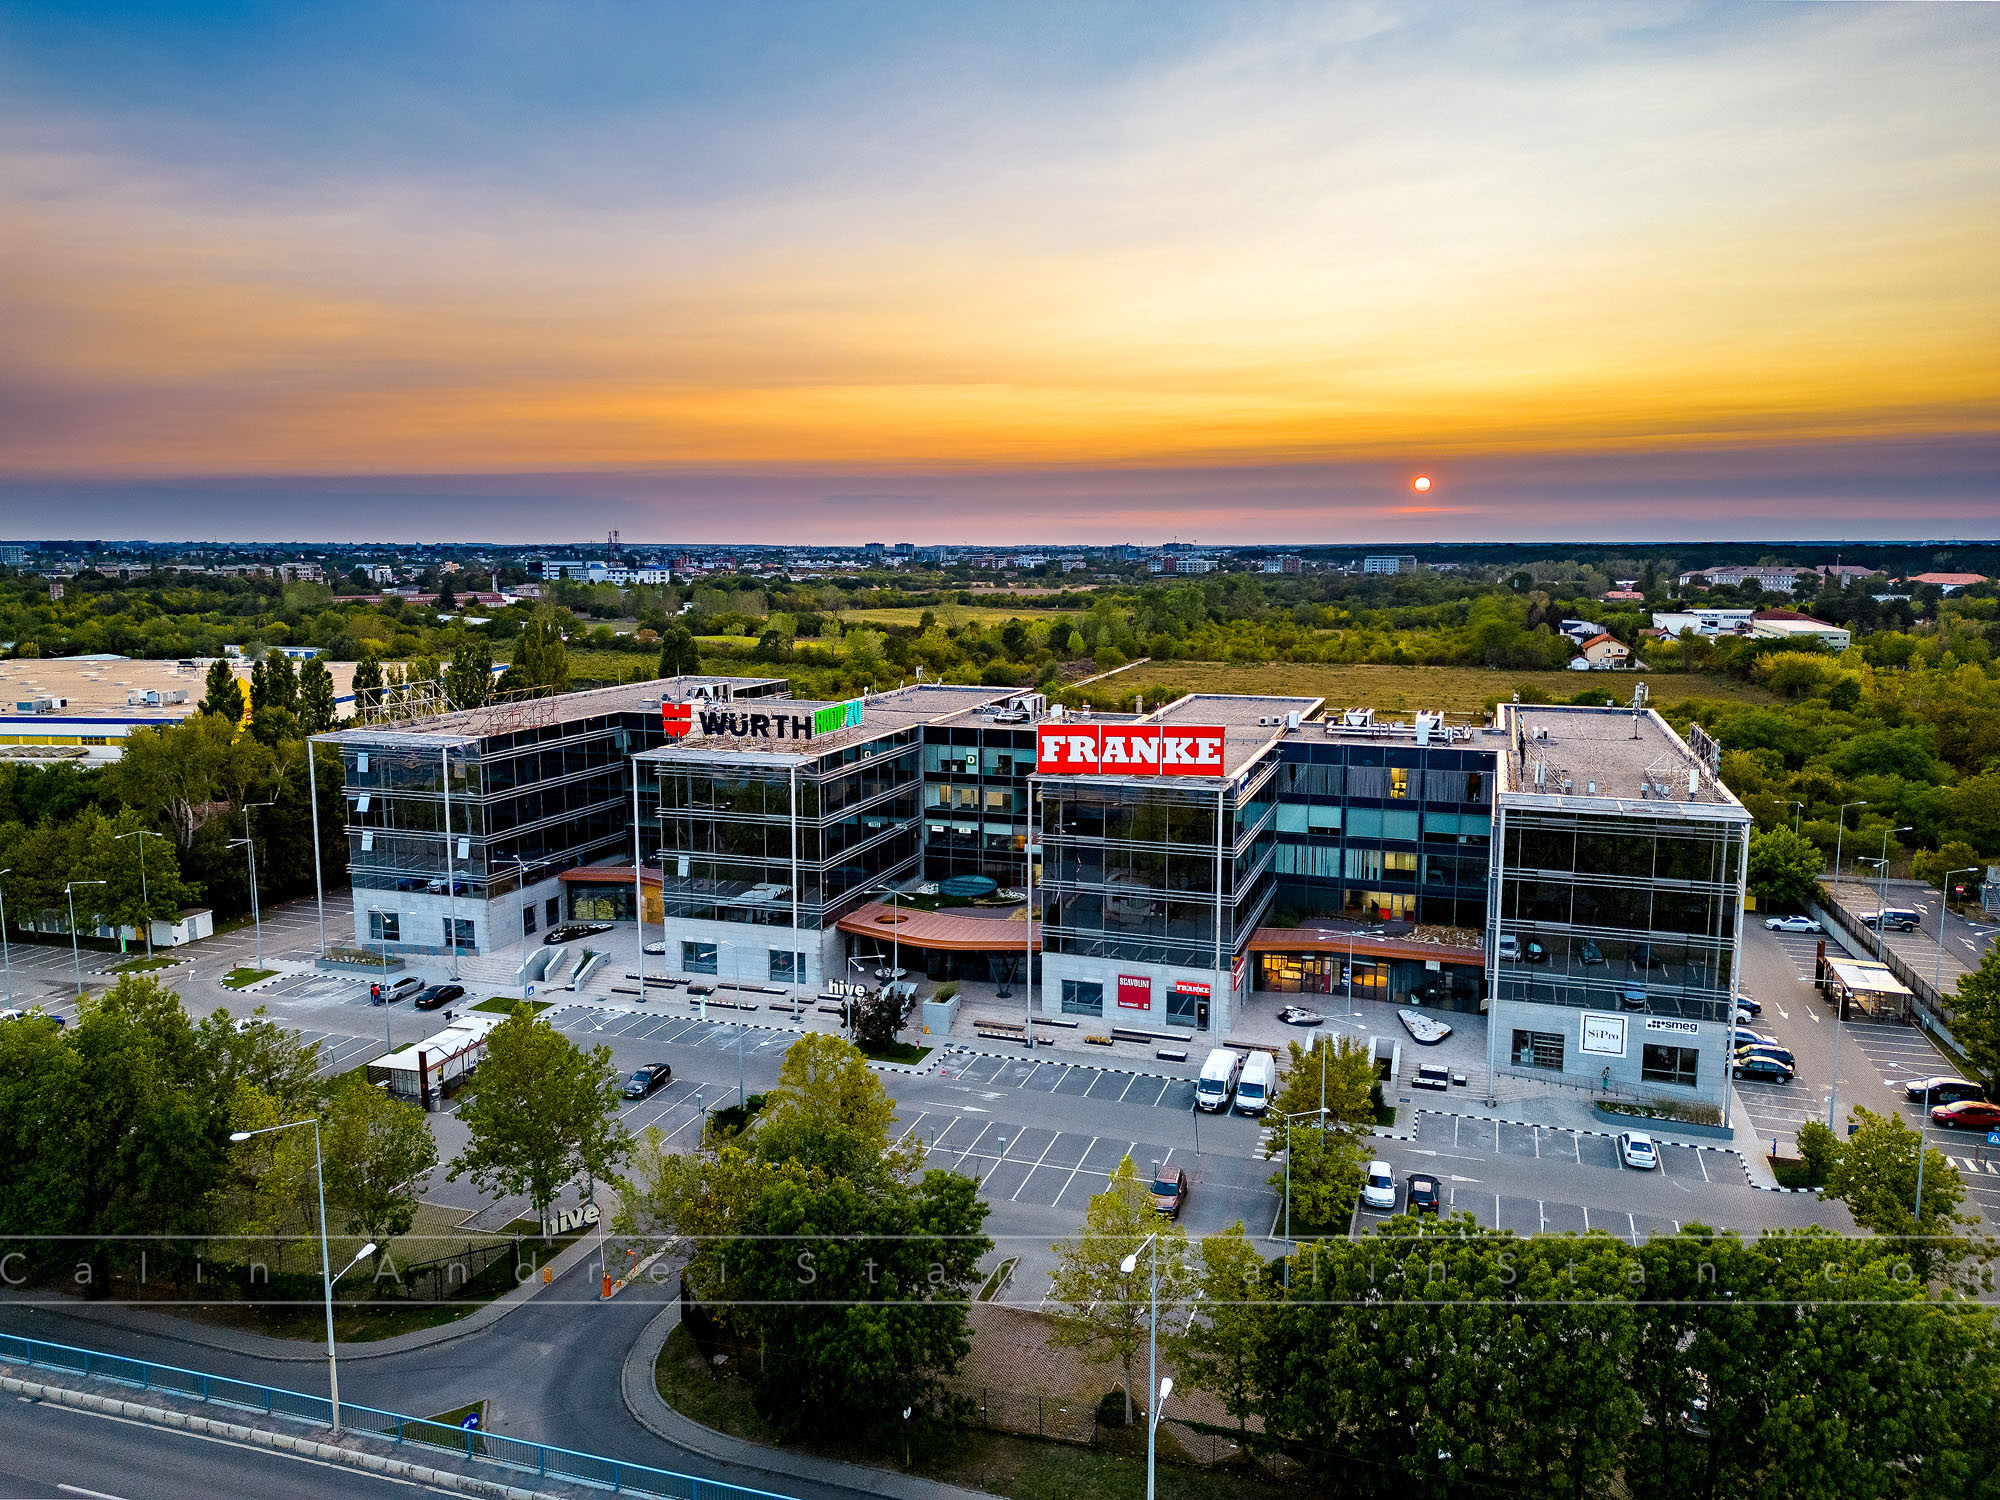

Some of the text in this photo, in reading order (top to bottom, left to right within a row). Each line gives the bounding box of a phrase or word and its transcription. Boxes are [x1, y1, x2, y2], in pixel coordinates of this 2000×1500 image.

[698, 711, 812, 740] WÜRTH
[815, 700, 862, 735] RADIO ZU
[967, 755, 975, 764] D
[1041, 735, 1221, 765] FRANKE
[828, 978, 866, 997] hive
[1176, 984, 1210, 994] FRANKE
[1665, 1020, 1698, 1033] smeg
